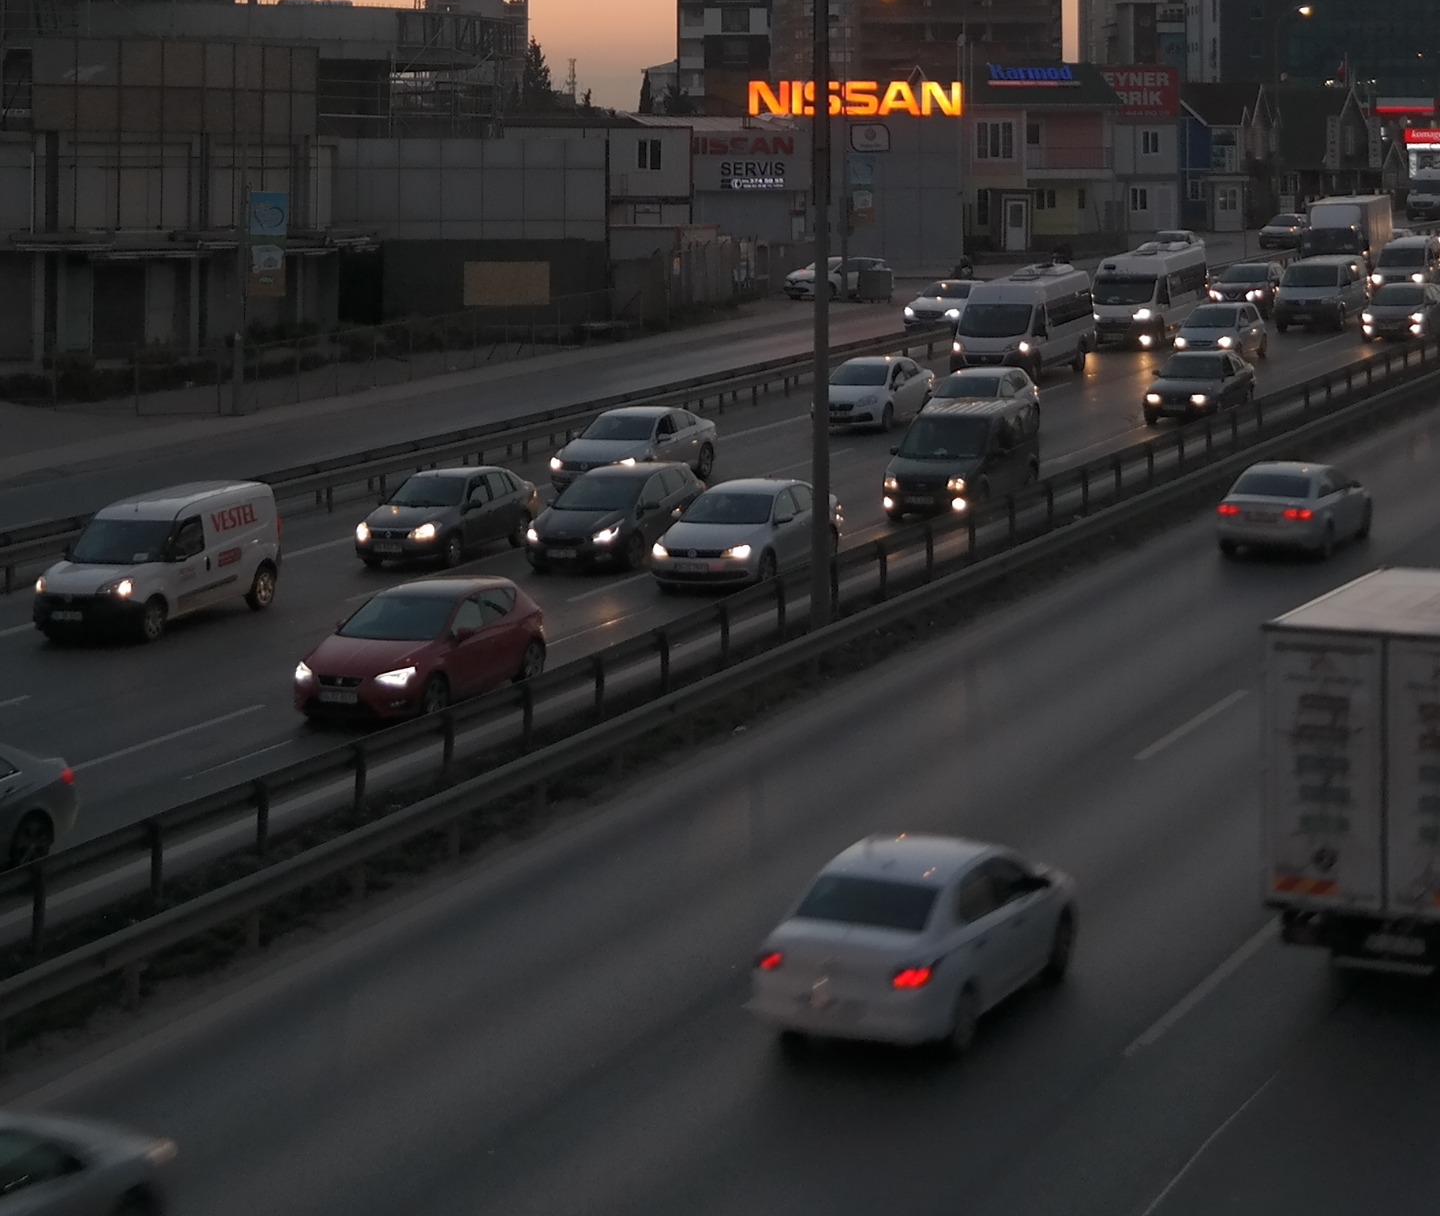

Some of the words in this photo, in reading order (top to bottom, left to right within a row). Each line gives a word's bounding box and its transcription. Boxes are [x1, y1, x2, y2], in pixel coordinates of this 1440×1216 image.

[1100, 71, 1169, 87] EYNER
[748, 80, 962, 116] NISSAN
[210, 502, 258, 532] VESTEL
